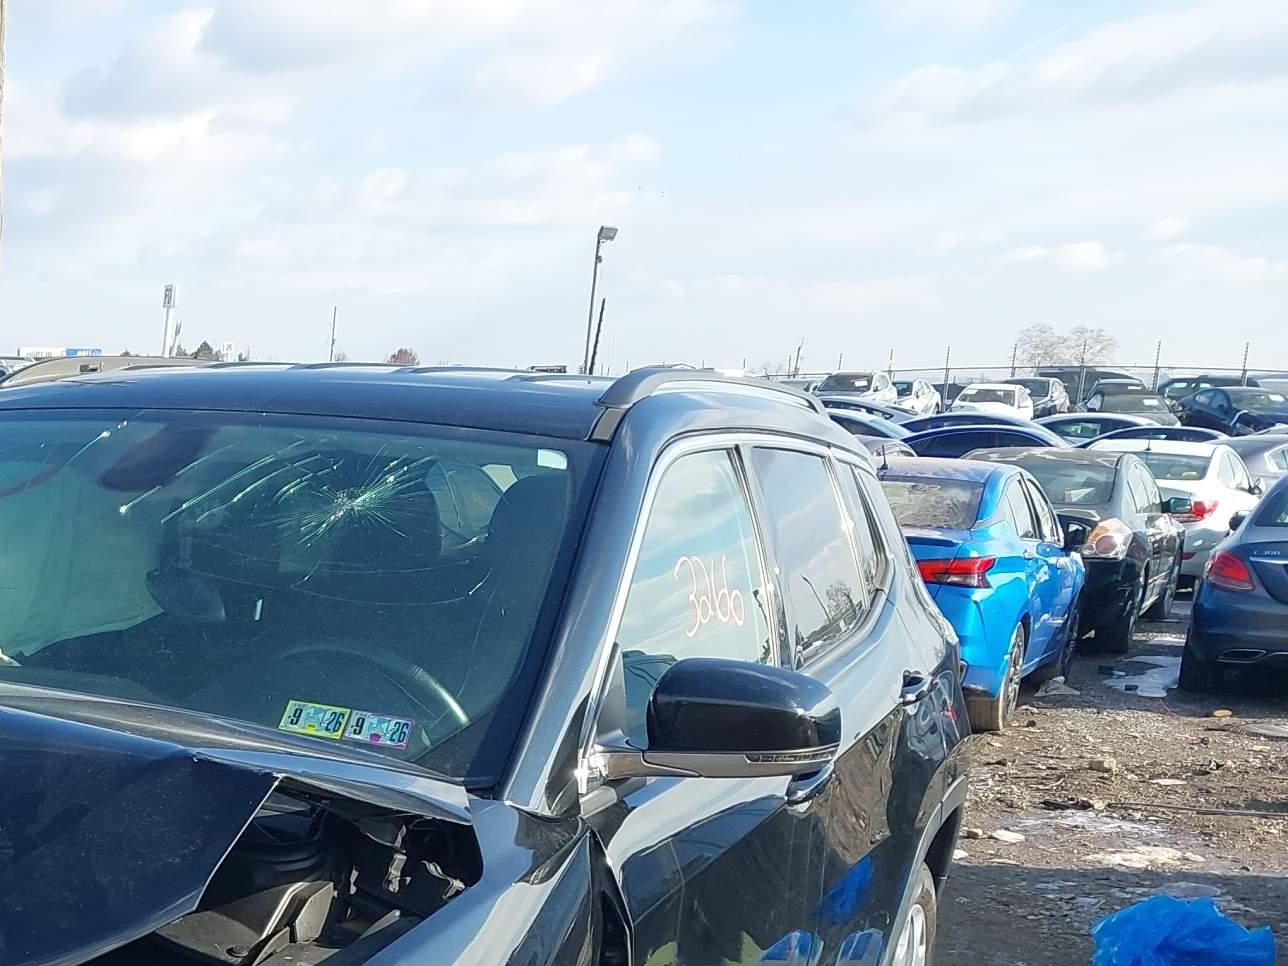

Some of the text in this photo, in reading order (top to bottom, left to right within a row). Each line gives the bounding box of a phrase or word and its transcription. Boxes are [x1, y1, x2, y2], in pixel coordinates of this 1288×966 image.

[289, 707, 345, 733] 9 26
[353, 716, 409, 744] 9 26
